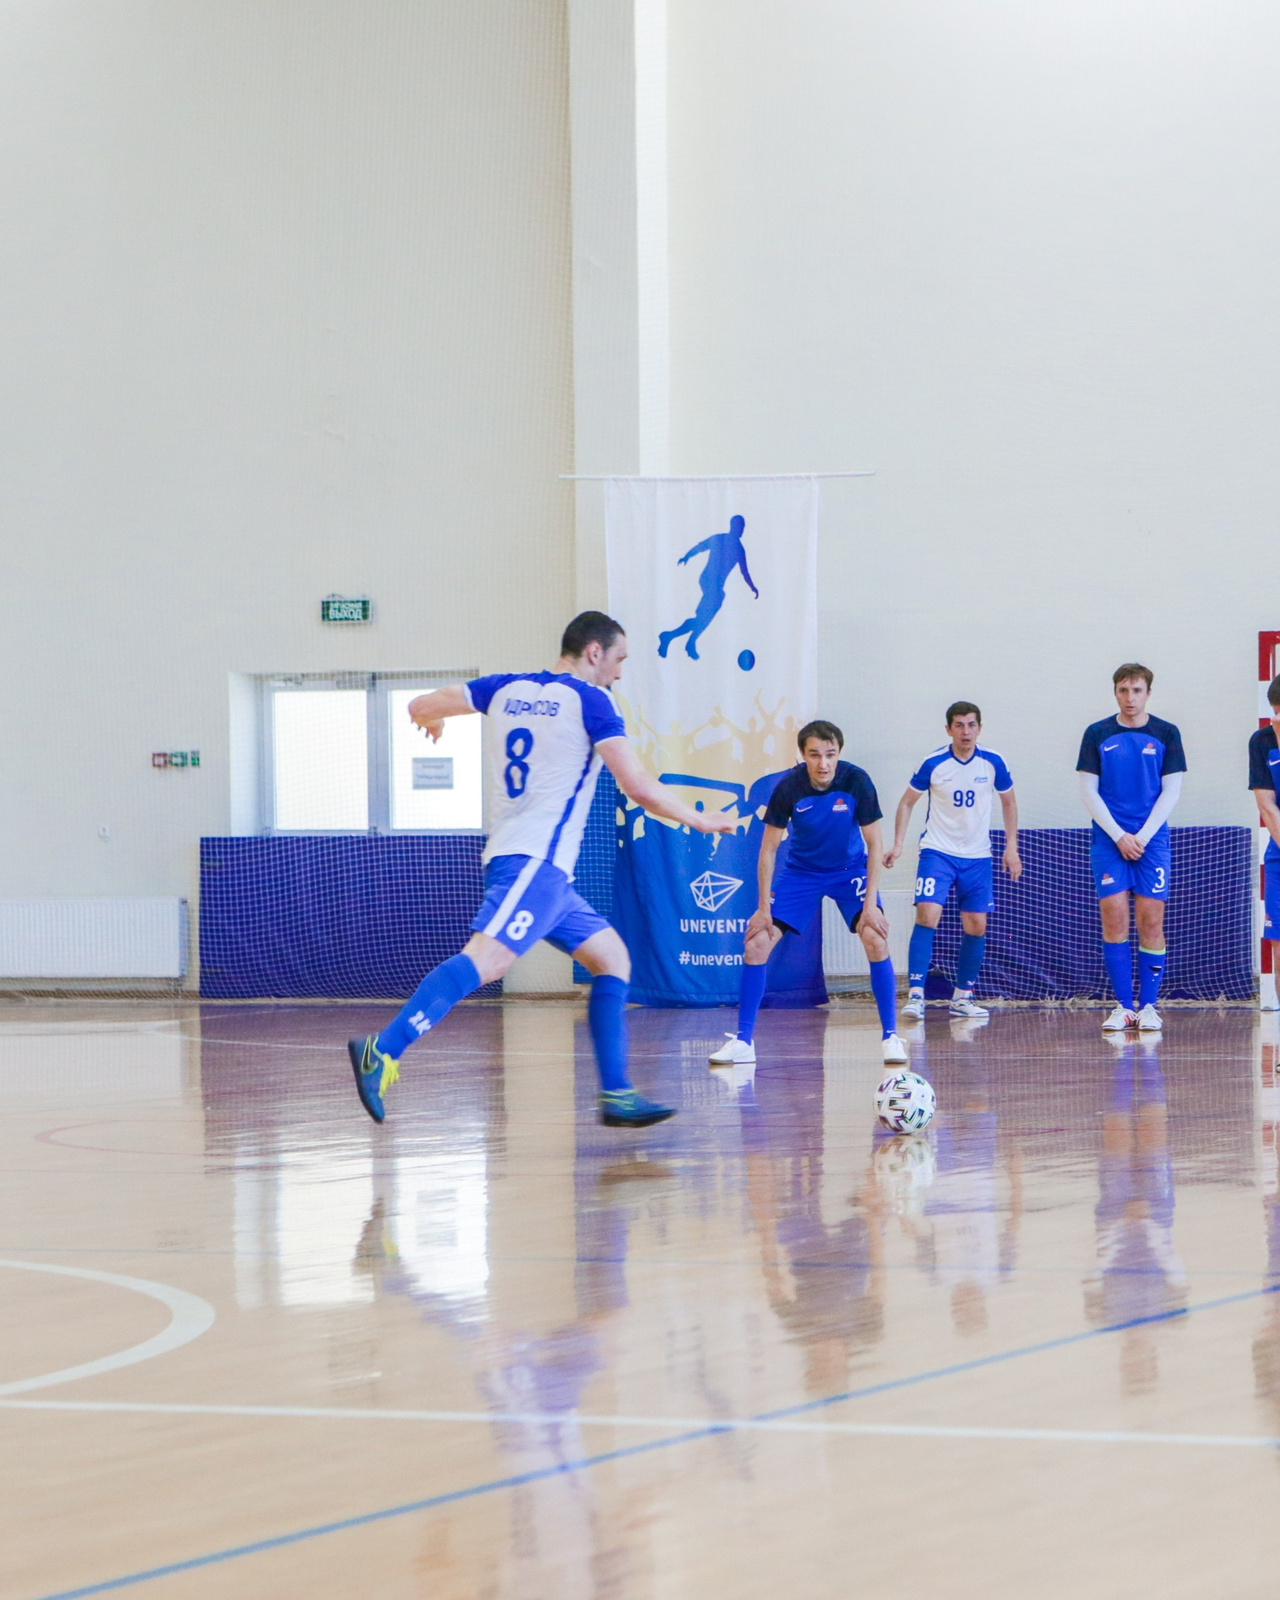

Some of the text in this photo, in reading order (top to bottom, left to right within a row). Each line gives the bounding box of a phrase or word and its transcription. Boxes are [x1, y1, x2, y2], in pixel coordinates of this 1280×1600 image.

[504, 727, 534, 799] 8
[953, 789, 976, 808] 98
[915, 877, 936, 897] 98
[1155, 867, 1166, 889] 3
[506, 910, 534, 941] 8
[679, 950, 745, 966] #uneven
